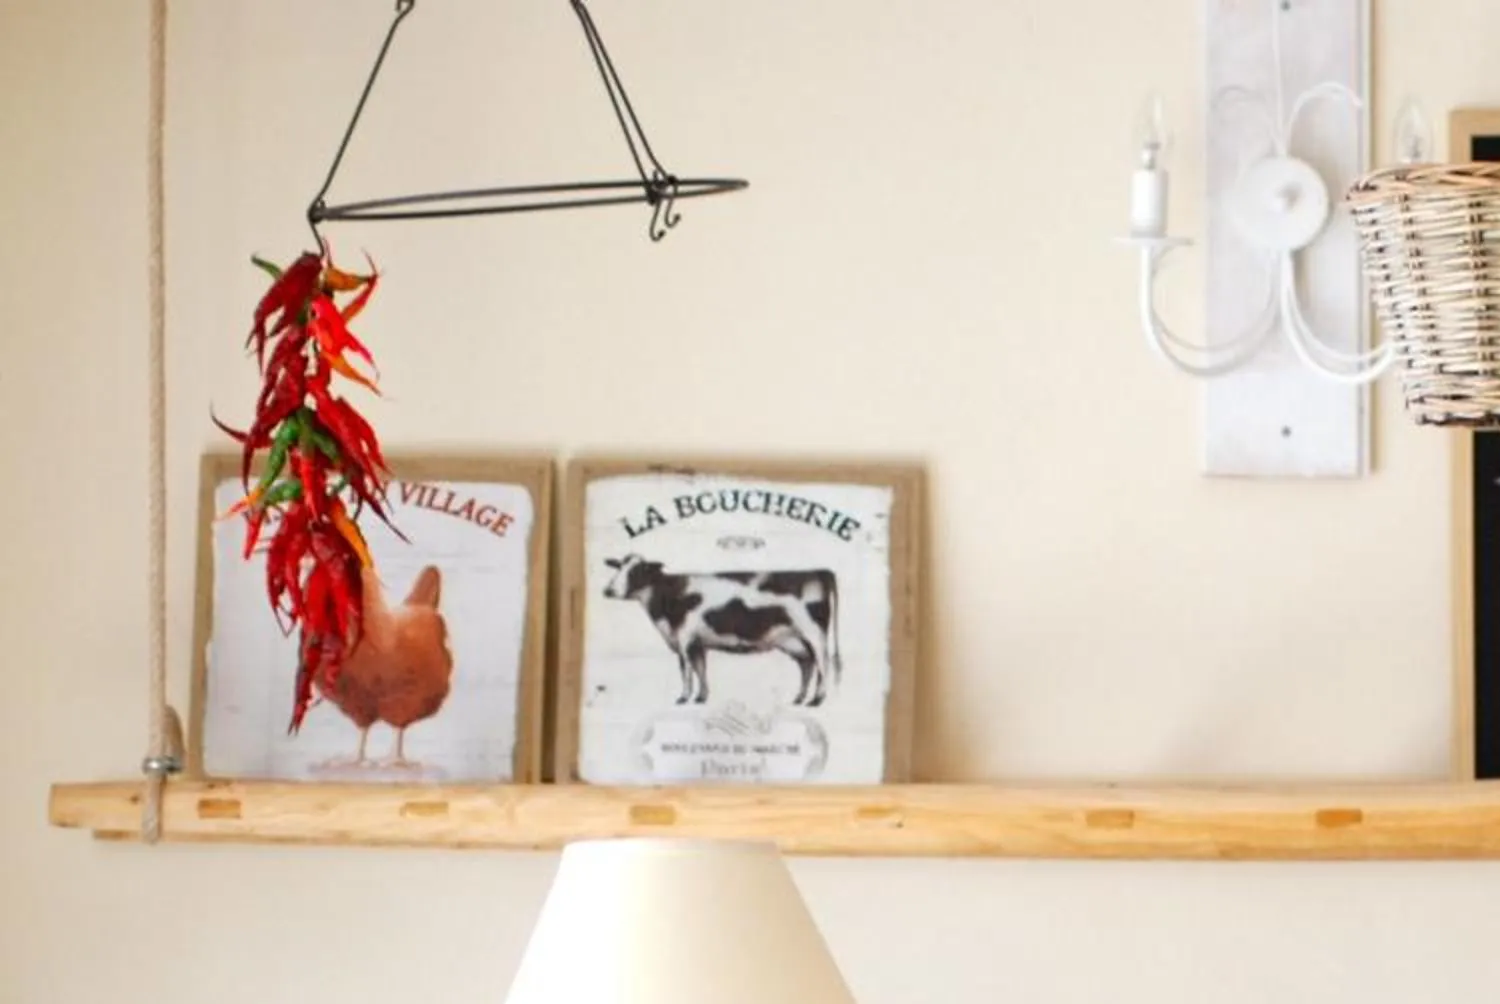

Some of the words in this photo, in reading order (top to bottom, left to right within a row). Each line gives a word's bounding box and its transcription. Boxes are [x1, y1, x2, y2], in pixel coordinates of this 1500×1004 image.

[400, 482, 515, 537] VILLAGE
[619, 504, 668, 540] LA
[672, 488, 862, 542] BOUCHERIE
